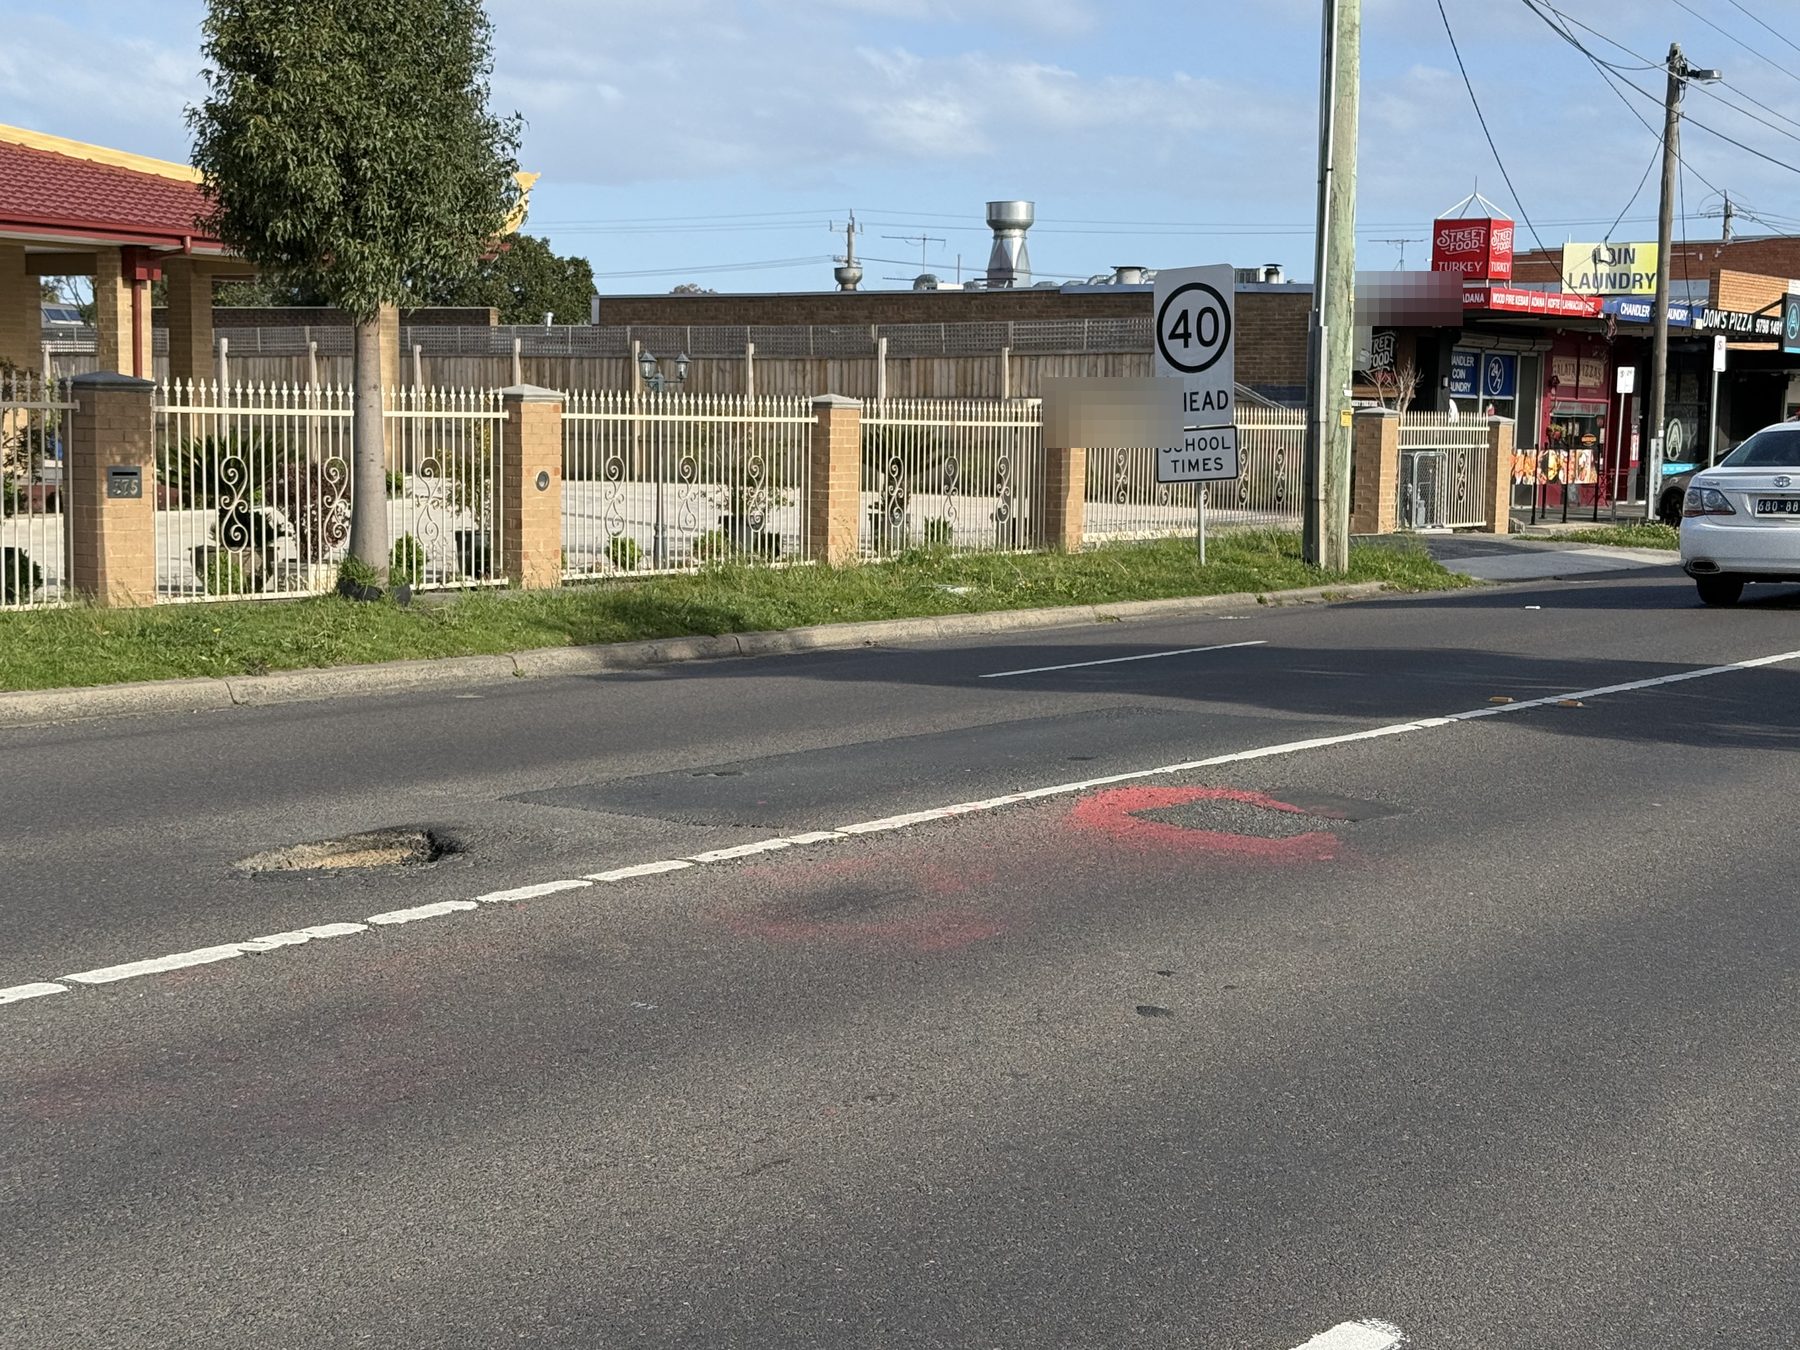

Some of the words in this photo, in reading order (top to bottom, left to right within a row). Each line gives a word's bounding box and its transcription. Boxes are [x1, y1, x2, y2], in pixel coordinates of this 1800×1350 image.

[1437, 229, 1486, 246] STREET
[1450, 239, 1480, 252] FOOD
[1438, 261, 1482, 272] TURKEY
[1568, 272, 1656, 290] LAUNDRY
[1621, 302, 1650, 318] CHANDLER
[1667, 308, 1688, 321] AUNDRY
[1703, 308, 1728, 329] DOM'S
[1729, 311, 1753, 332] PIZZA
[1168, 306, 1219, 348] 40
[1451, 355, 1474, 367] ANDLER
[1184, 390, 1229, 412] EAD
[1163, 436, 1231, 453] HOOL
[1171, 457, 1223, 473] TIMES
